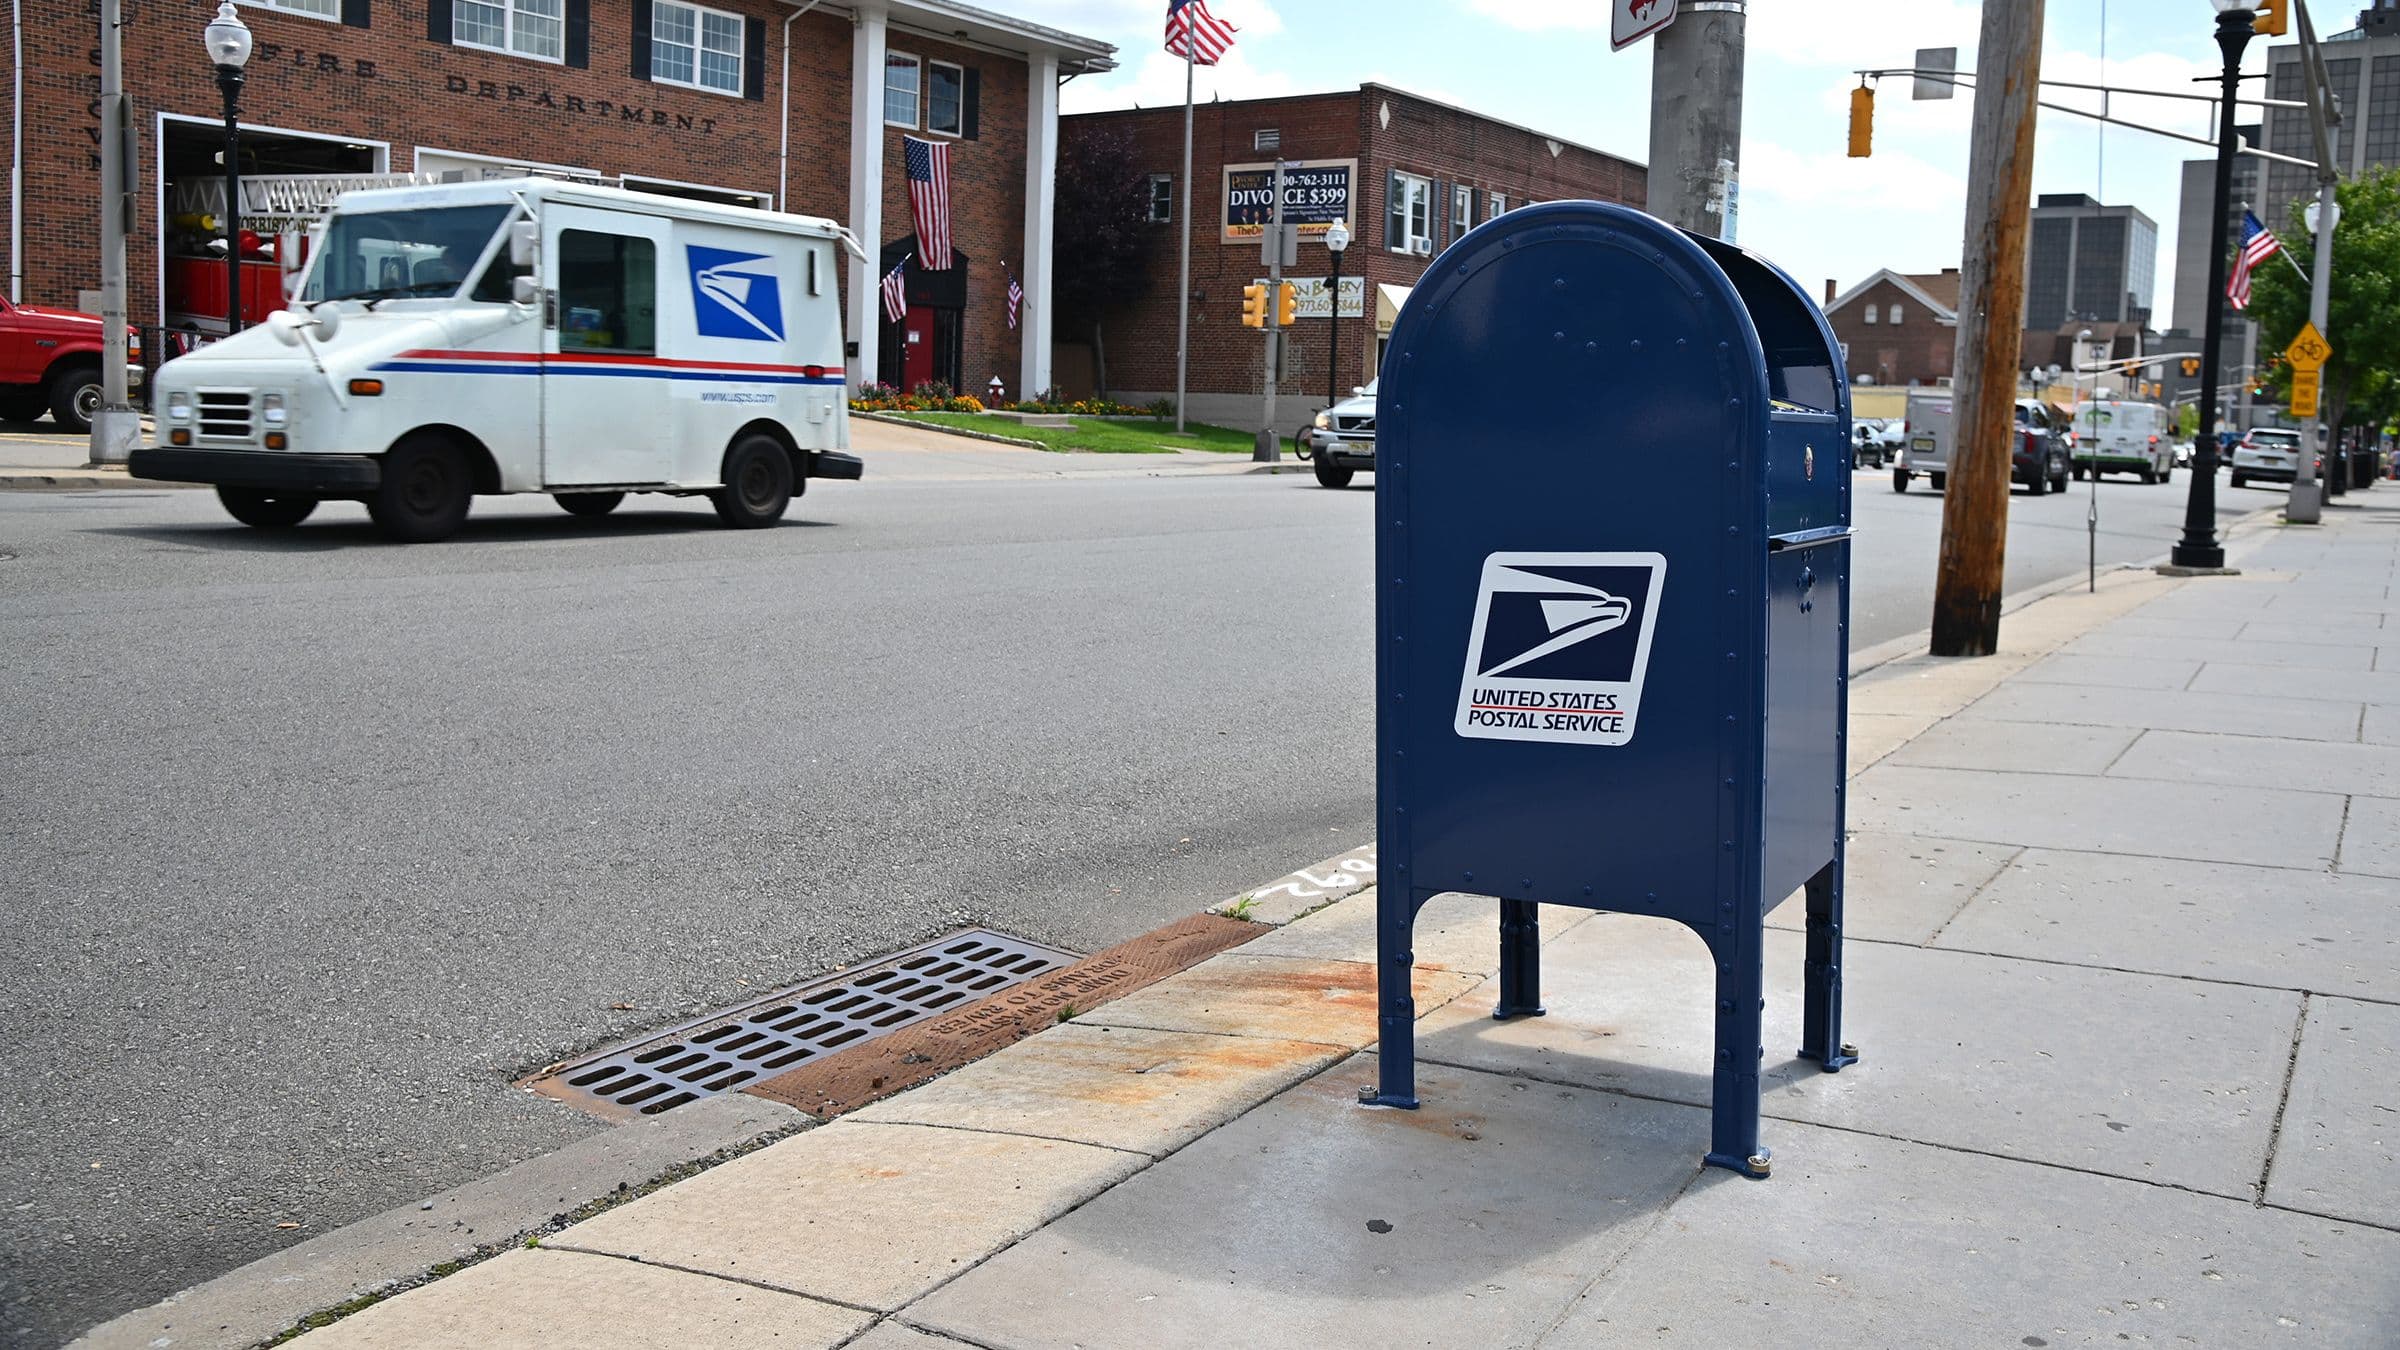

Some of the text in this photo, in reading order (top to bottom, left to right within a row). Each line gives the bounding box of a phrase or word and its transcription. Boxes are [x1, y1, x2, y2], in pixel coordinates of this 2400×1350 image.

[259, 41, 717, 134] FIRE DEPARTMENT
[1266, 173, 1346, 187] 1-00-762-3111
[1230, 187, 1347, 206] DIVOCE $399
[1472, 688, 1618, 711] UNITED STATES
[1468, 710, 1539, 729] POSTAL
[1075, 969, 1133, 993] DUMP
[1007, 991, 1045, 1005] TO
[1041, 990, 1079, 1006] NO
[929, 1004, 1009, 1034] RIVER
